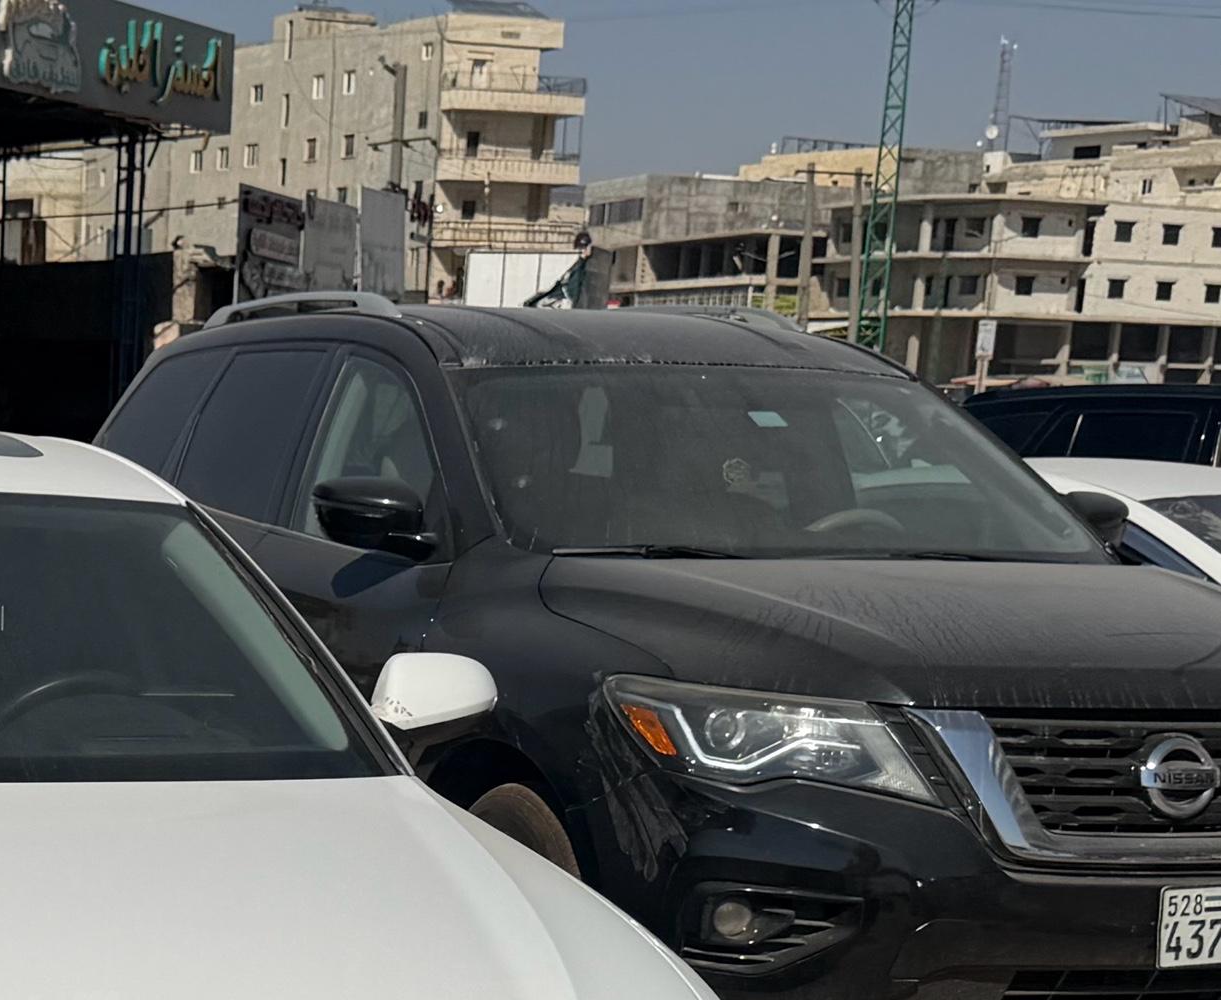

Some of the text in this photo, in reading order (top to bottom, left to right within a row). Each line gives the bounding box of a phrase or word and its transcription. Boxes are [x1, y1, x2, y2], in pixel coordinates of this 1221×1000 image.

[1153, 771, 1215, 785] NISSAN
[1167, 894, 1203, 917] 528
[1165, 919, 1221, 961] 437
